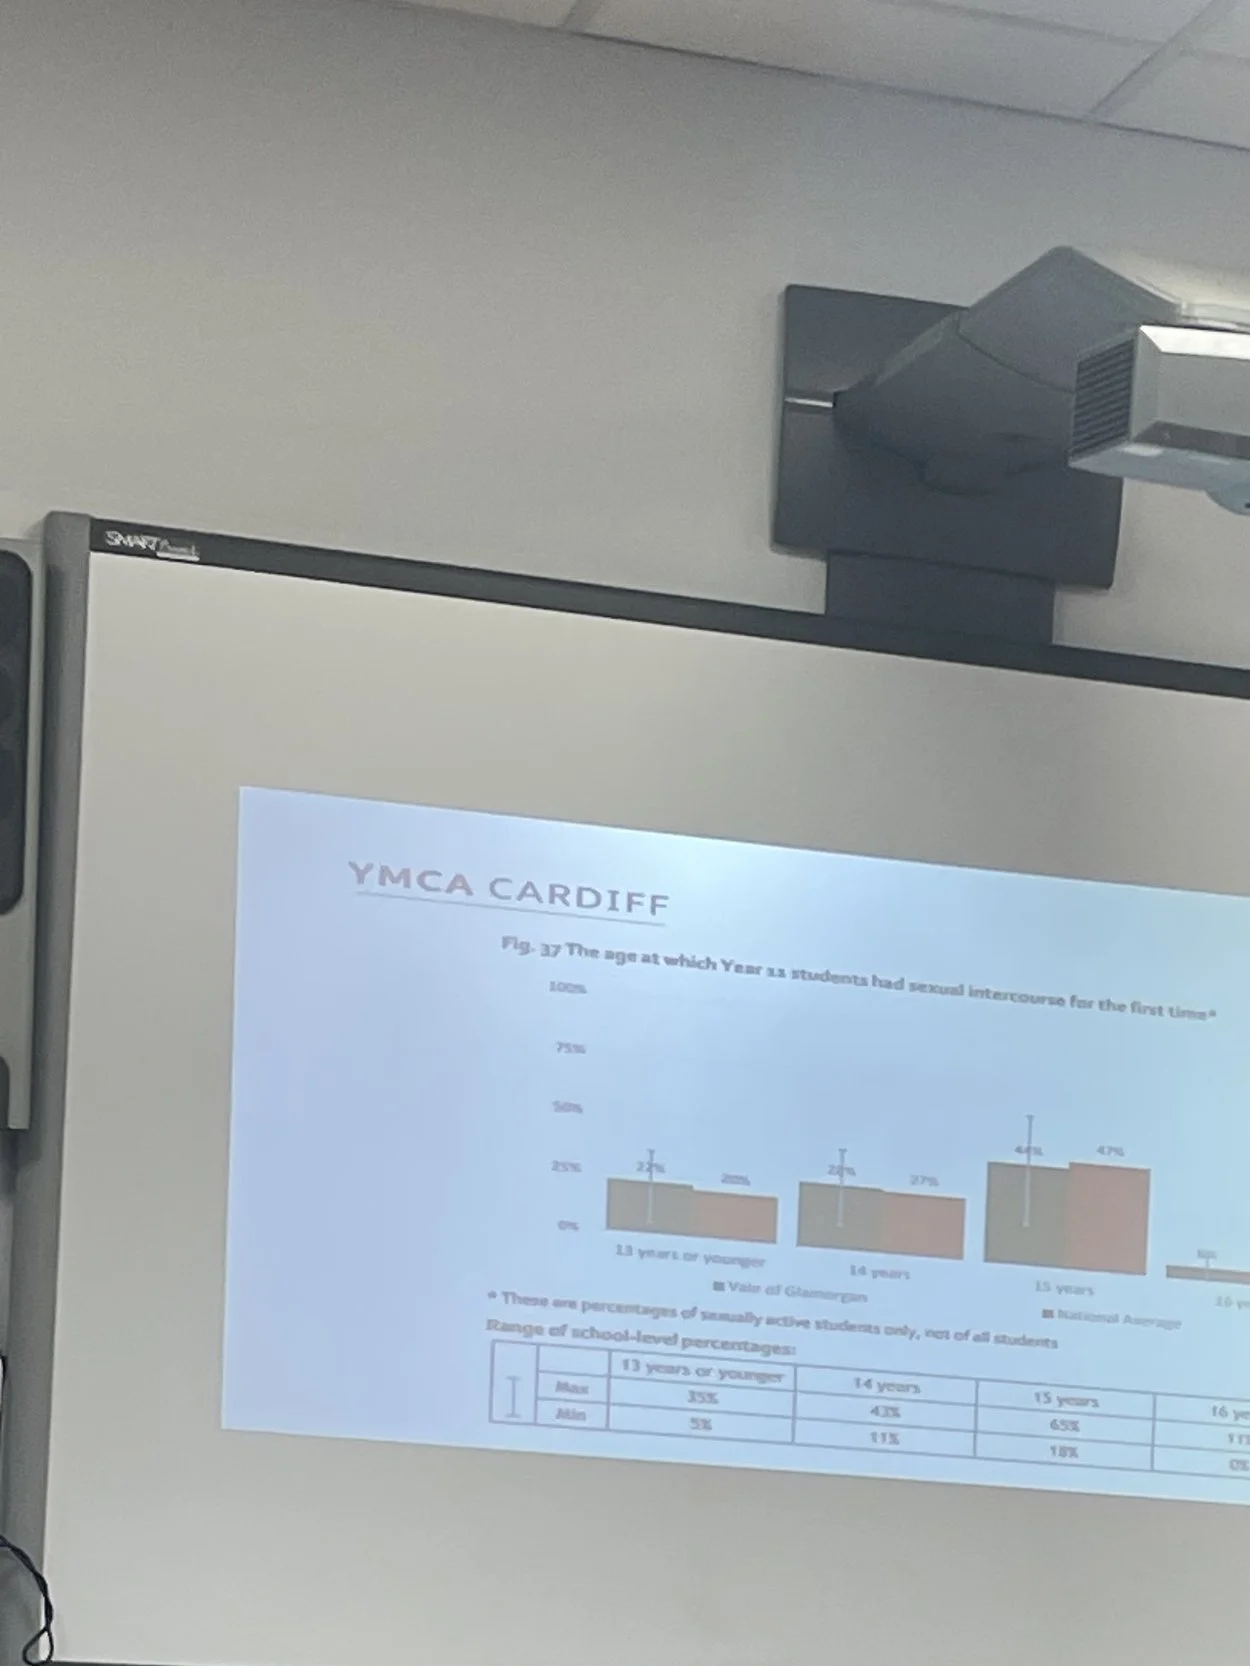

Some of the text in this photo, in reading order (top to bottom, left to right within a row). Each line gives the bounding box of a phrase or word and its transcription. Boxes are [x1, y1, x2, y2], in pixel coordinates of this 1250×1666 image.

[349, 861, 669, 915] YMCA CARDIFF
[501, 936, 534, 956] Fig.
[540, 943, 561, 958] 37
[565, 942, 599, 959] The
[604, 950, 637, 966] age
[641, 951, 660, 966] at
[664, 953, 717, 971] which
[721, 958, 763, 976] Year
[791, 968, 868, 987] students
[872, 974, 905, 991] had
[909, 980, 964, 997] sexual
[968, 984, 1065, 1008] intercourse
[1070, 995, 1094, 1010] for
[1099, 998, 1127, 1013] the
[1130, 1001, 1164, 1018] first
[616, 1244, 766, 1269] 13 years or younger
[850, 1264, 910, 1280] 14 years
[765, 1284, 782, 1295] of
[1035, 1280, 1094, 1297] 15 years
[502, 1291, 549, 1307] These
[552, 1297, 577, 1309] are
[581, 1300, 677, 1319] percentages
[681, 1306, 698, 1320] of
[701, 1310, 762, 1327] sexually
[766, 1315, 811, 1329] active
[815, 1319, 880, 1335] students
[884, 1324, 921, 1341] only,
[925, 1327, 950, 1341] not
[954, 1329, 970, 1342] of
[973, 1330, 990, 1344] all
[993, 1333, 1058, 1349] students
[1123, 1314, 1182, 1330] Average
[486, 1319, 544, 1337] Range
[548, 1324, 568, 1337] of
[571, 1326, 678, 1346] school-level
[622, 1359, 787, 1385] 13 years or younger
[555, 1380, 589, 1394] Max
[853, 1377, 921, 1394] 14 years
[1034, 1392, 1099, 1408] 15 years
[555, 1407, 587, 1421] Min
[1211, 1405, 1228, 1418] 16
